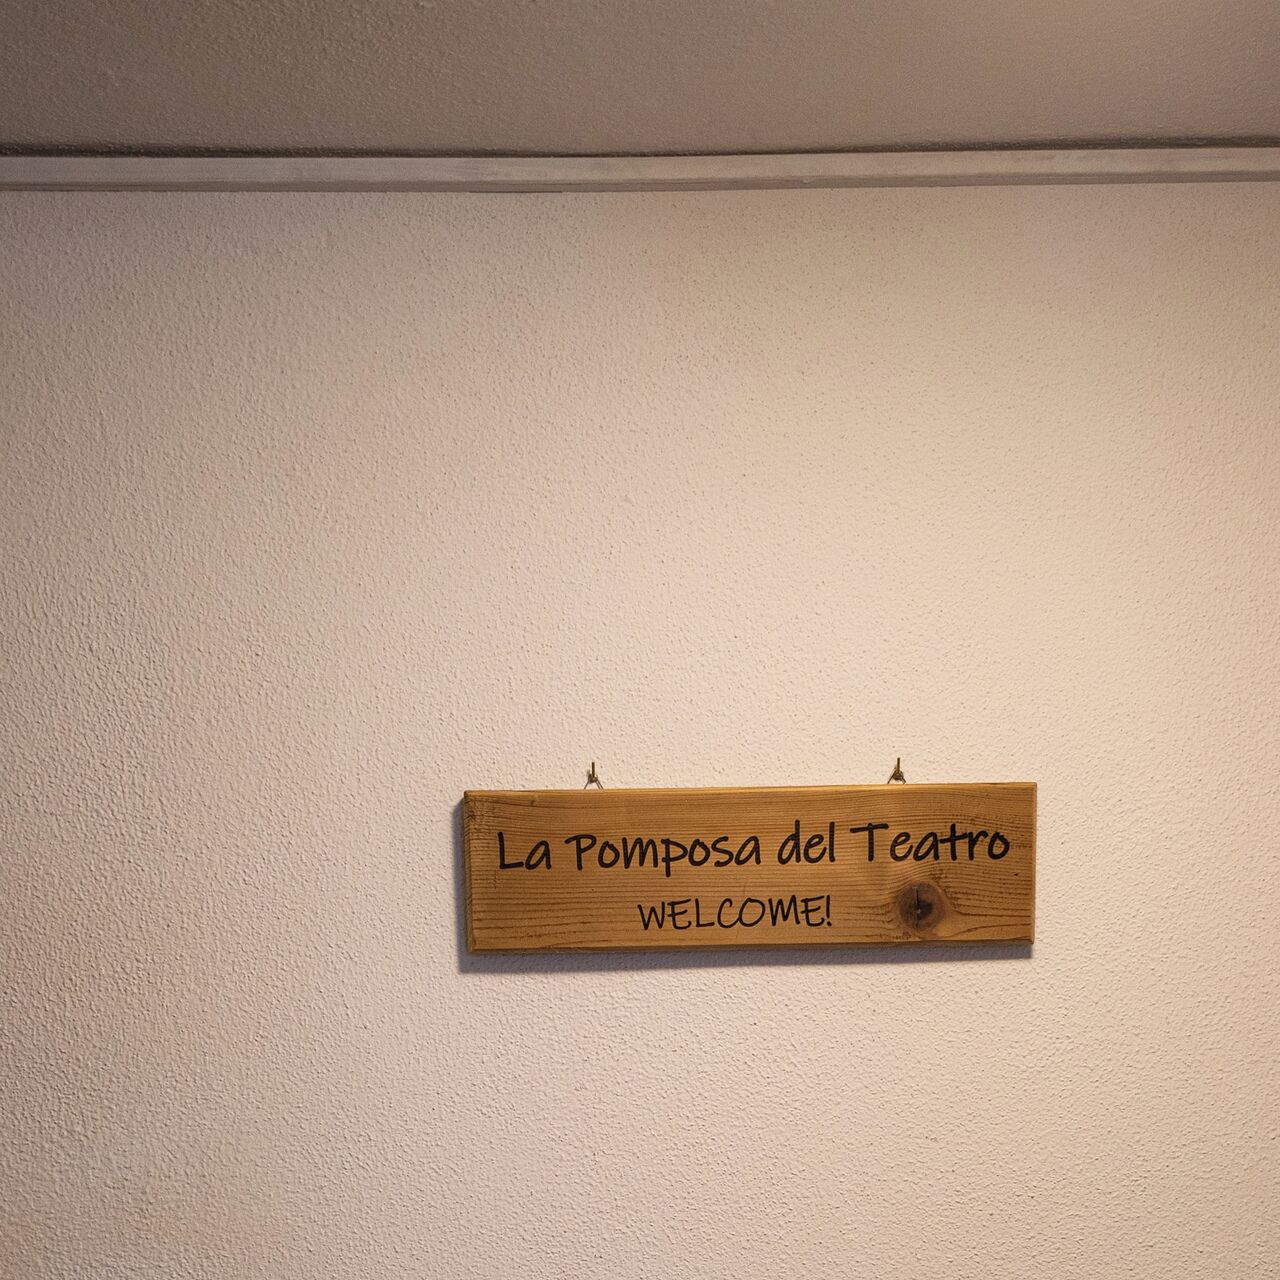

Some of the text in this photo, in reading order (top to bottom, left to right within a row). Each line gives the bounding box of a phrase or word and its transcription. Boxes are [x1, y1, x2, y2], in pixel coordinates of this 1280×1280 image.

[497, 820, 1011, 878] La Pomposa del Teatro
[637, 894, 832, 931] WELCOME!
